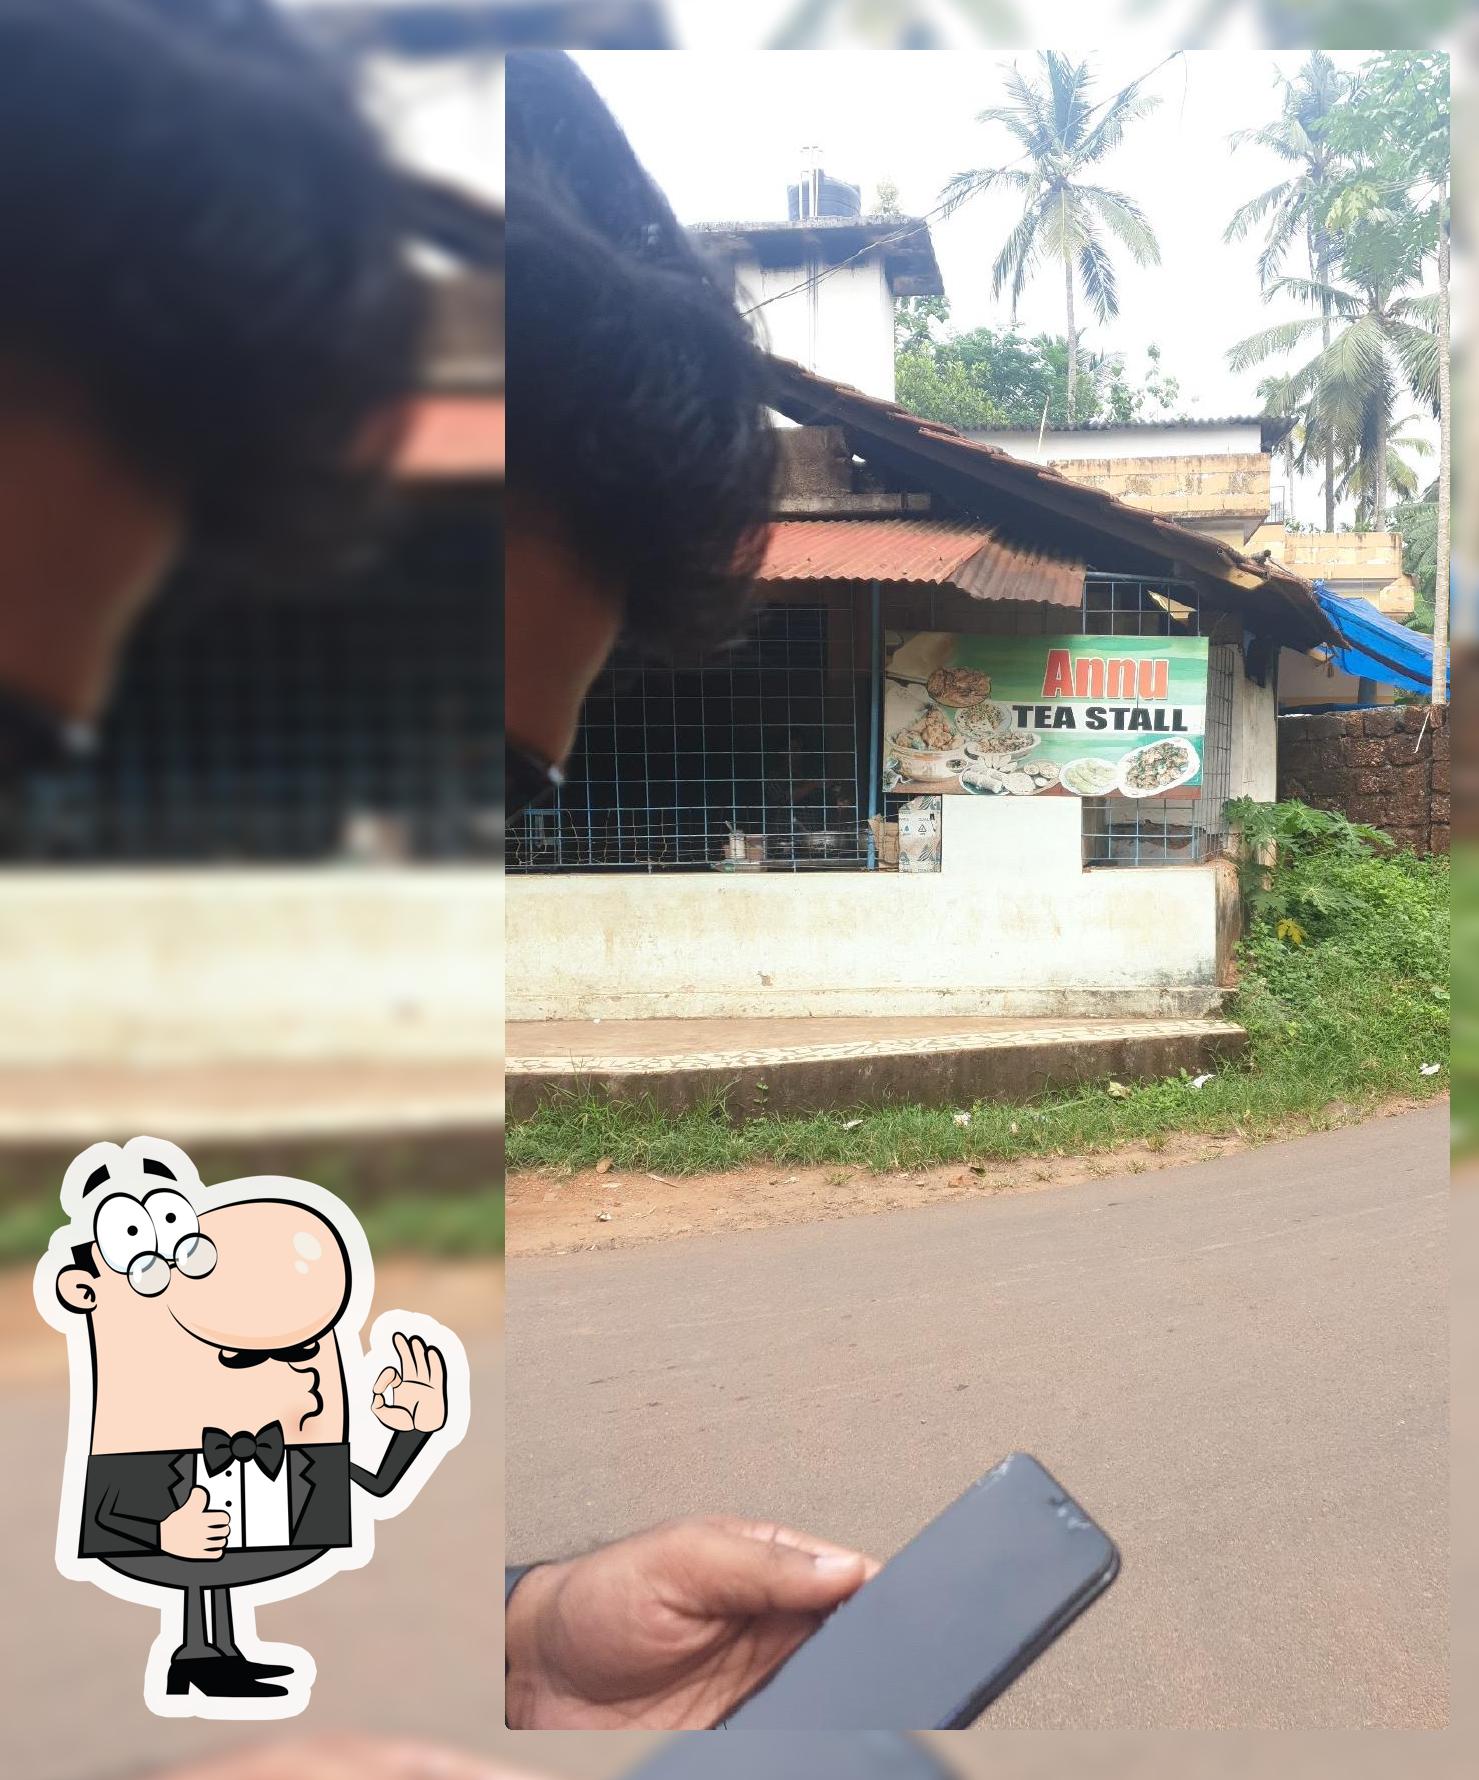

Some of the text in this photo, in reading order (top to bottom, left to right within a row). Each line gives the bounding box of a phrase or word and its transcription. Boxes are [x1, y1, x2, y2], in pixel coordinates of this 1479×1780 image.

[1041, 649, 1169, 700] Annu
[1012, 705, 1188, 732] TEA STALL
